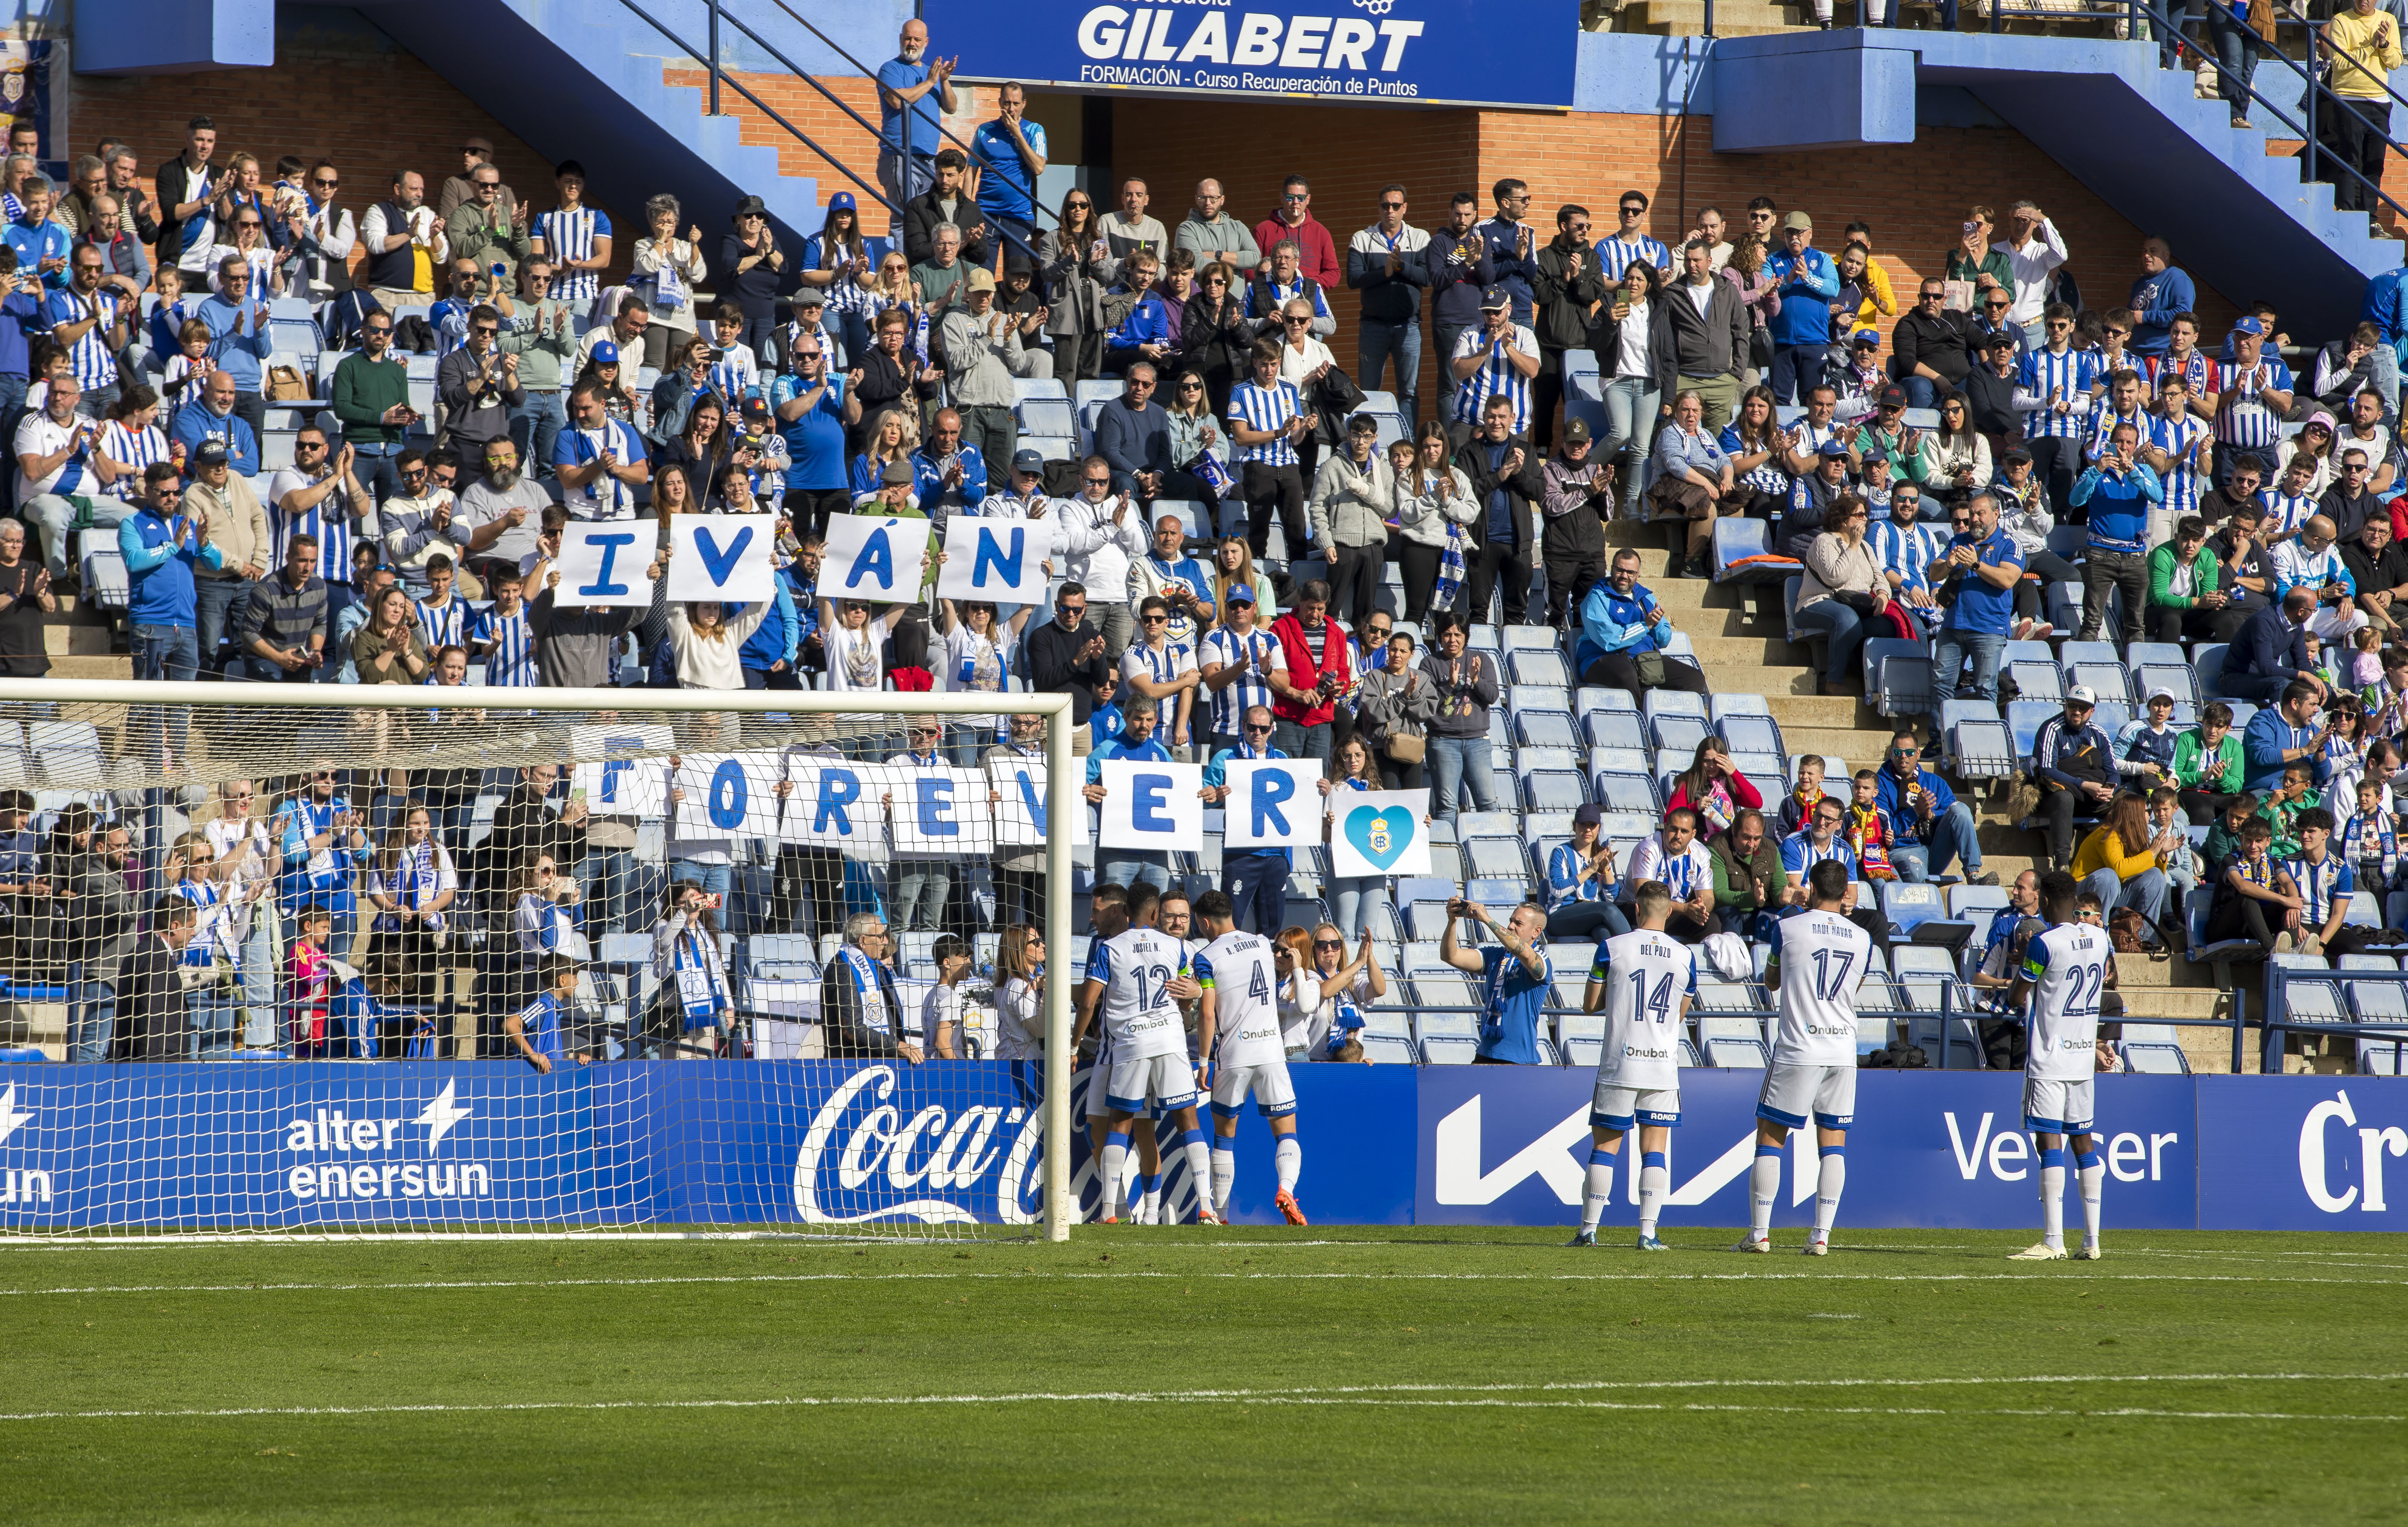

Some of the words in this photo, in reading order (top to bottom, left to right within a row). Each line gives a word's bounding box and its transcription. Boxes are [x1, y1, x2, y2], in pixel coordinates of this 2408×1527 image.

[1078, 5, 1425, 72] GILABERT
[1081, 65, 1180, 86] FORMACIÓN
[1195, 70, 1238, 89] Curso
[1243, 73, 1341, 93] Recuperación
[1345, 76, 1363, 93] de
[1368, 78, 1418, 96] Puntos
[1813, 923, 1829, 934] RAÚL
[1832, 926, 1852, 938] NAVAS
[1133, 943, 1152, 953] JOSIEL
[1154, 942, 1160, 952] N.
[1226, 947, 1234, 955] R.
[1236, 940, 1260, 953] SERRANO
[1641, 945, 1651, 955] DEL
[1655, 947, 1670, 958] POZO
[1248, 960, 1269, 1006] 4
[1811, 948, 1855, 1001] 17
[1129, 965, 1171, 1012] 12
[1629, 969, 1674, 1023] 14
[2062, 963, 2102, 1016] 22
[1129, 1018, 1169, 1033] Onubat
[1808, 1025, 1848, 1035] Onubat
[1626, 1047, 1668, 1058] Onubat
[1166, 1093, 1195, 1105] ROMERO
[1270, 1101, 1296, 1112] ROMERO
[287, 1108, 399, 1151] alter
[289, 1163, 488, 1198] enersun
